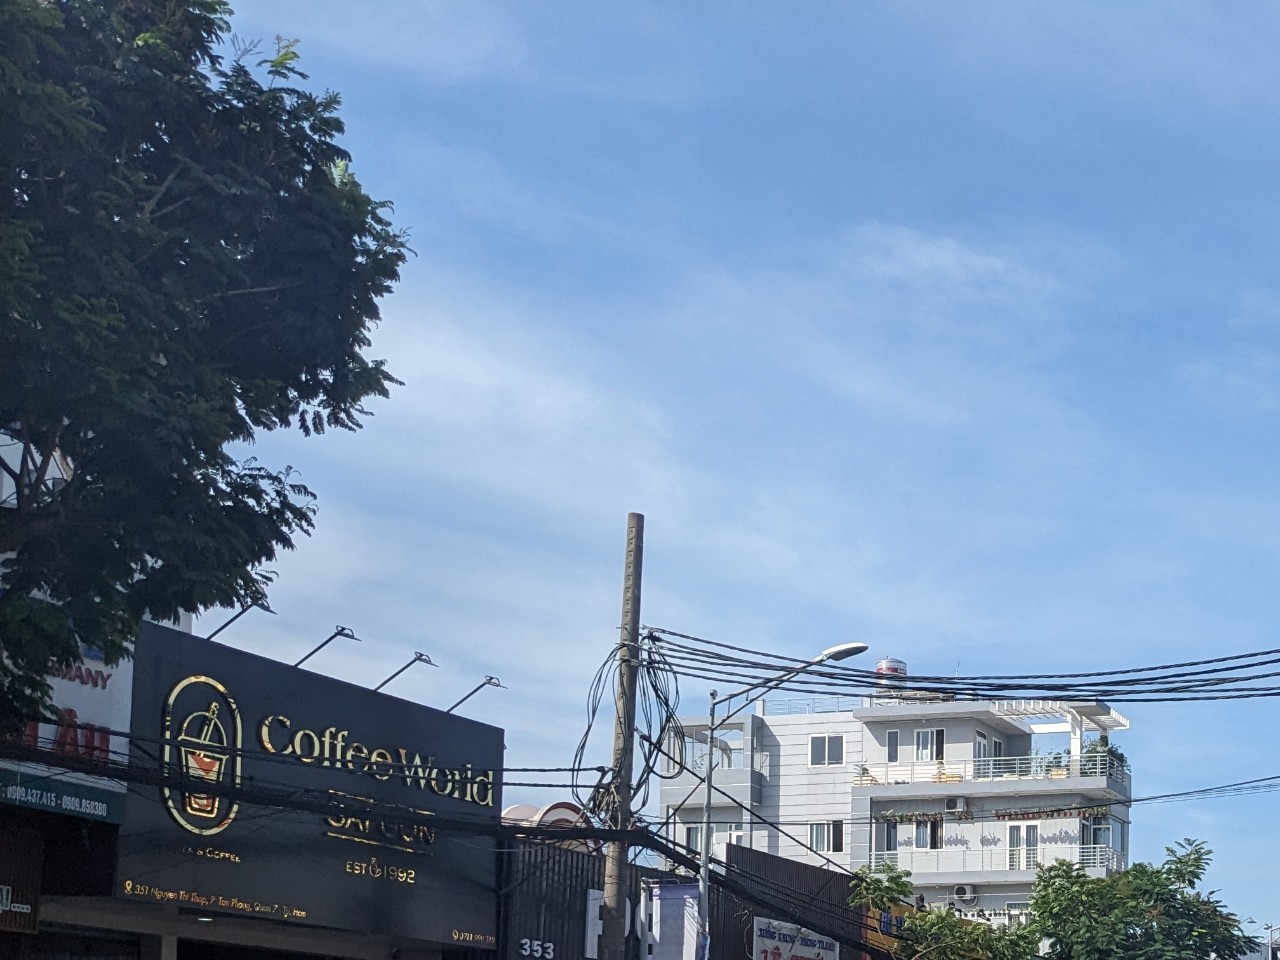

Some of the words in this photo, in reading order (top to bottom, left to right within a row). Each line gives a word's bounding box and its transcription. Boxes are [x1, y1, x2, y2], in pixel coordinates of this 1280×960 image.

[260, 714, 392, 780] Coffee
[398, 747, 494, 807] World
[346, 860, 367, 874] EST
[384, 866, 416, 884] 1992
[520, 938, 555, 960] 353
